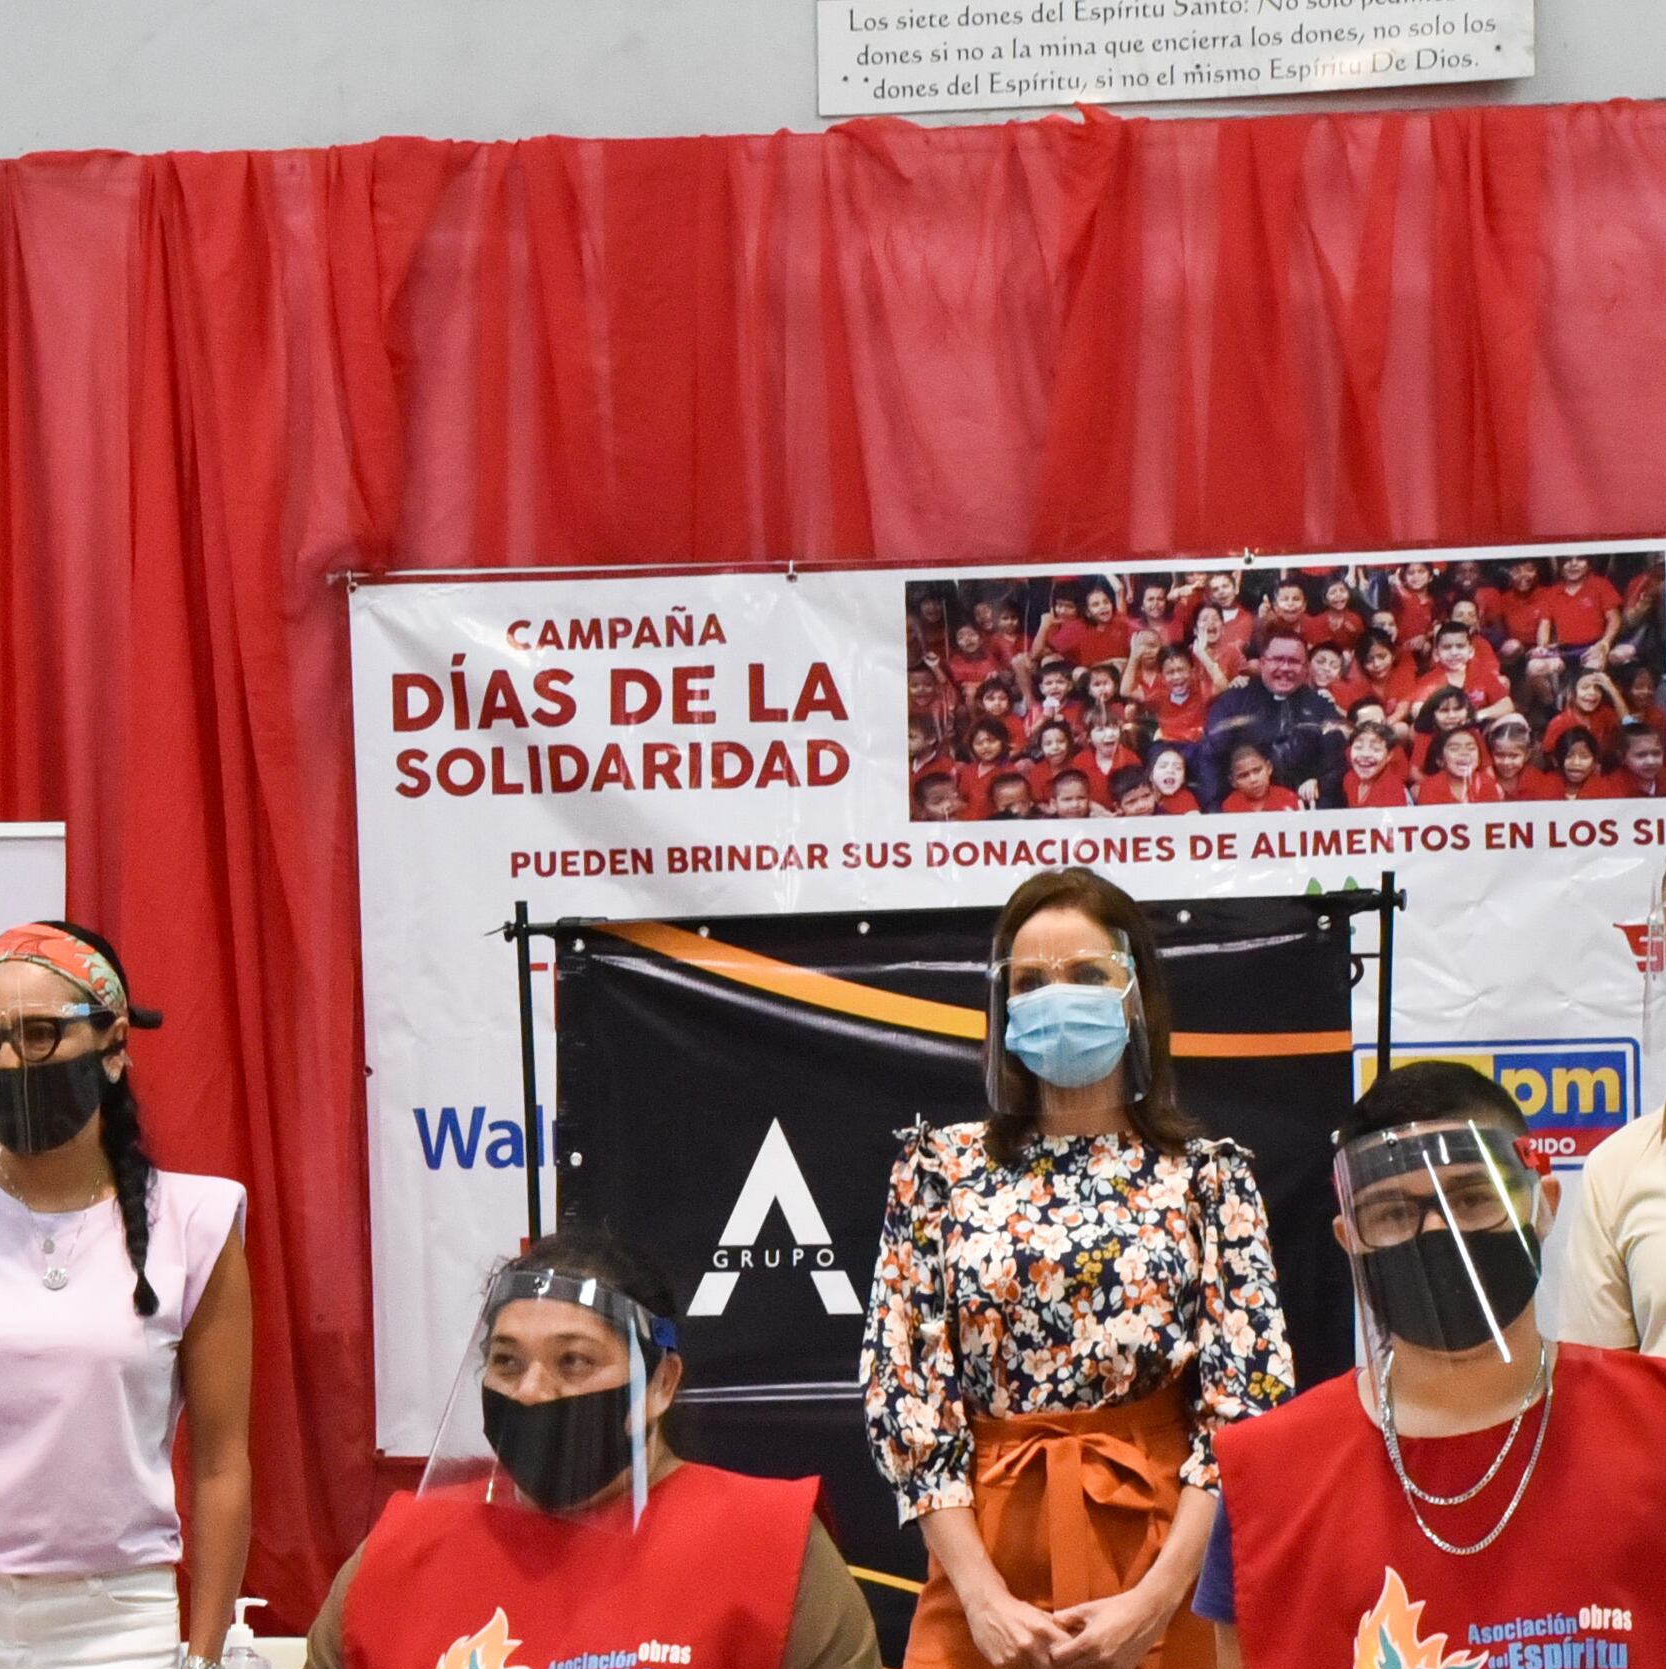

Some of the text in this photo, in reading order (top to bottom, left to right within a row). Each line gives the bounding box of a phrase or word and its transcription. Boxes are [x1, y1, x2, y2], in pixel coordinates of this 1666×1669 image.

[850, 8, 887, 31] Los
[896, 9, 949, 29] siete
[957, 5, 1022, 27] dones
[1031, 0, 1062, 23] del
[1073, 0, 1164, 28] Espíritu
[856, 12, 1495, 66] dones si no a la mina que encierra los dones, no solo los
[873, 78, 938, 100] dones
[947, 74, 979, 96] del
[989, 70, 1086, 96] Espíritu,
[1095, 68, 1113, 88] si
[1122, 71, 1149, 87] no
[1156, 65, 1174, 85] el
[1183, 64, 1260, 85] mismo
[1270, 55, 1361, 83] Espíritu
[1371, 49, 1406, 73] De
[506, 605, 726, 650] CAMPAÑA
[391, 653, 849, 732] DÍAS DE LA
[395, 738, 850, 799] SOLIDARIDAD
[510, 840, 653, 878] PUEDEN
[668, 837, 827, 873] BRINDAR
[841, 840, 912, 868] SUS
[925, 833, 1175, 868] DONACIONES
[1189, 831, 1237, 861] DE
[1249, 823, 1470, 859] ALIMENTOS
[1484, 820, 1535, 851] EN
[1547, 818, 1619, 848] LOS
[712, 1248, 834, 1268] GRUPO
[1467, 1603, 1632, 1644] Asociación obras
[638, 1639, 691, 1664] obras
